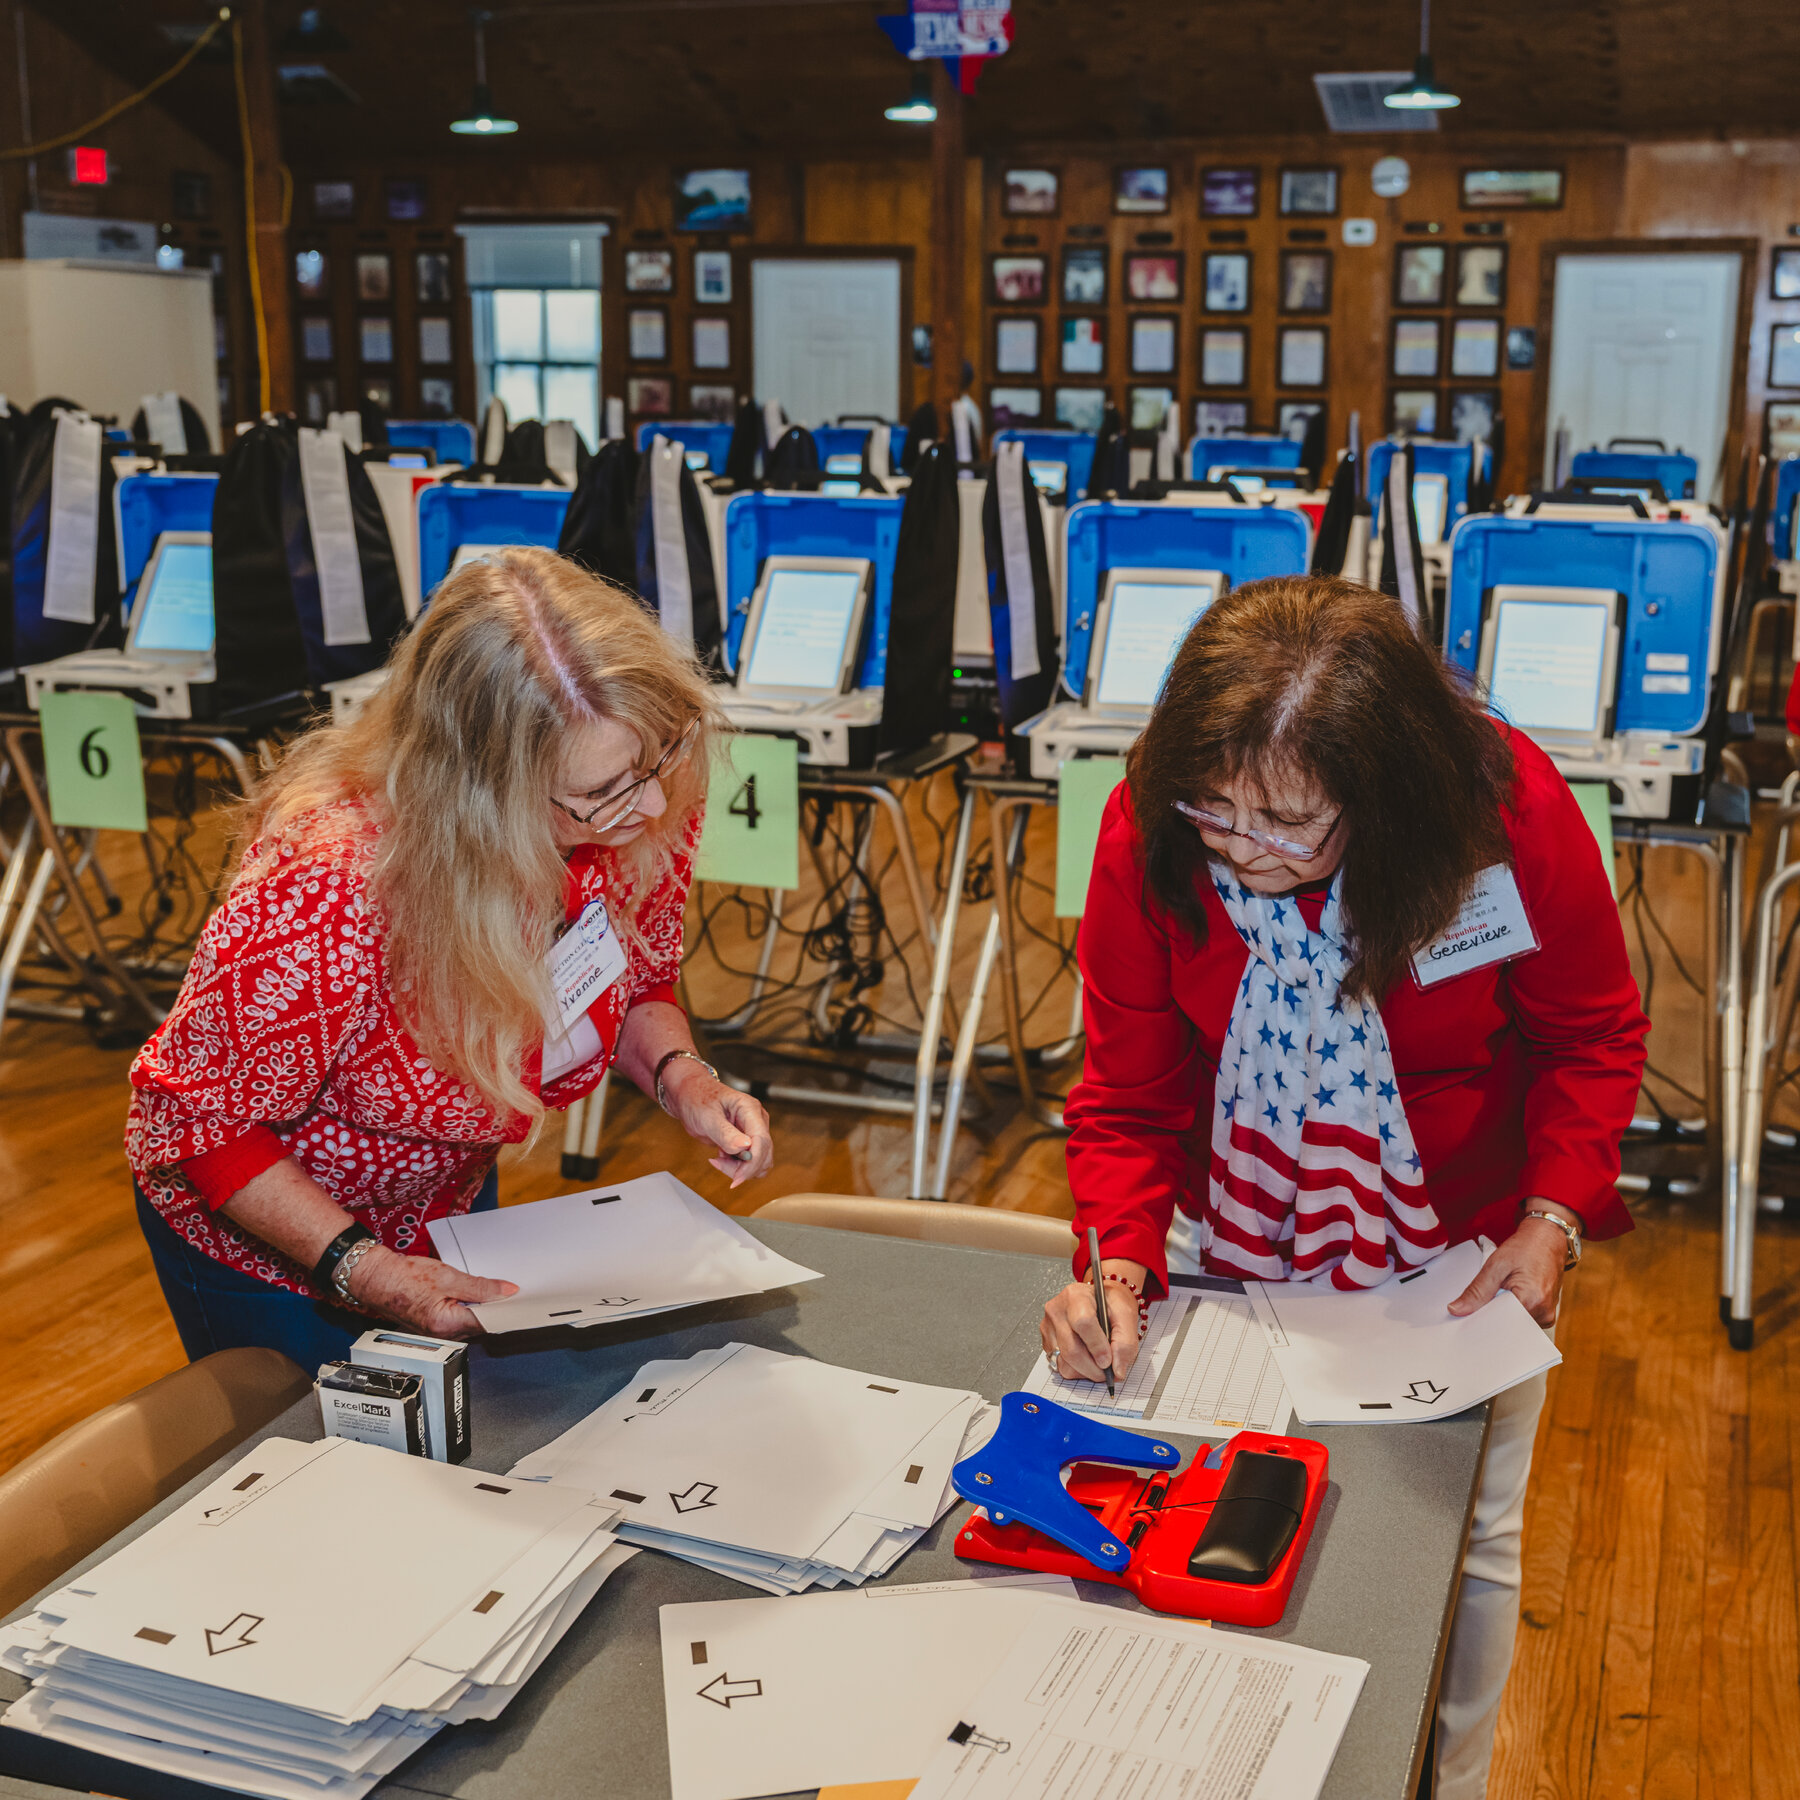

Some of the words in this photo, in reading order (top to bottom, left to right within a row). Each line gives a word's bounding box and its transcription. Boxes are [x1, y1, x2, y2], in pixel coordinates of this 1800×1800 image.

[79, 726, 110, 779] 6
[728, 774, 762, 829] 4
[1429, 925, 1511, 960] Genevieve
[1445, 922, 1488, 942] Republican
[560, 966, 603, 1011] Yvonne
[564, 963, 595, 995] Republican
[333, 1399, 391, 1417] ExcelMark
[453, 1373, 464, 1445] ExcelMark
[417, 1404, 428, 1459] xcelMark
